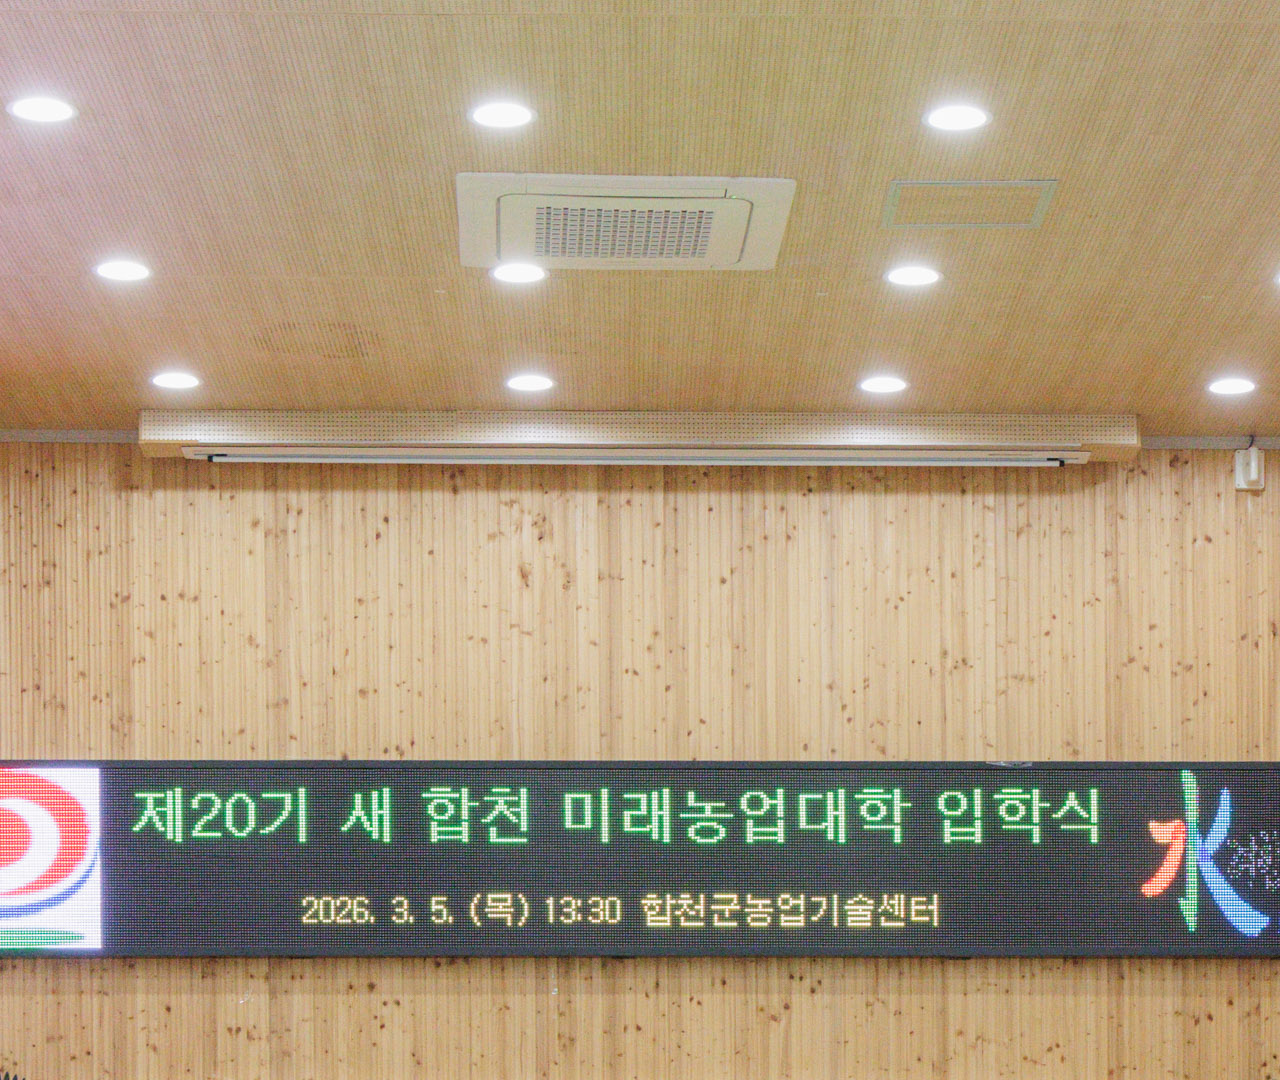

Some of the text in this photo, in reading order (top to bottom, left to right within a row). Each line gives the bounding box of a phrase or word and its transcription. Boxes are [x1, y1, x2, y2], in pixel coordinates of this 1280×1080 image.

[131, 785, 1100, 844] 제20기 새 합천 미래농업대학 입학식
[301, 892, 940, 930] 2026. 3. 5. (목) 13:30 합천군농업기술센터
